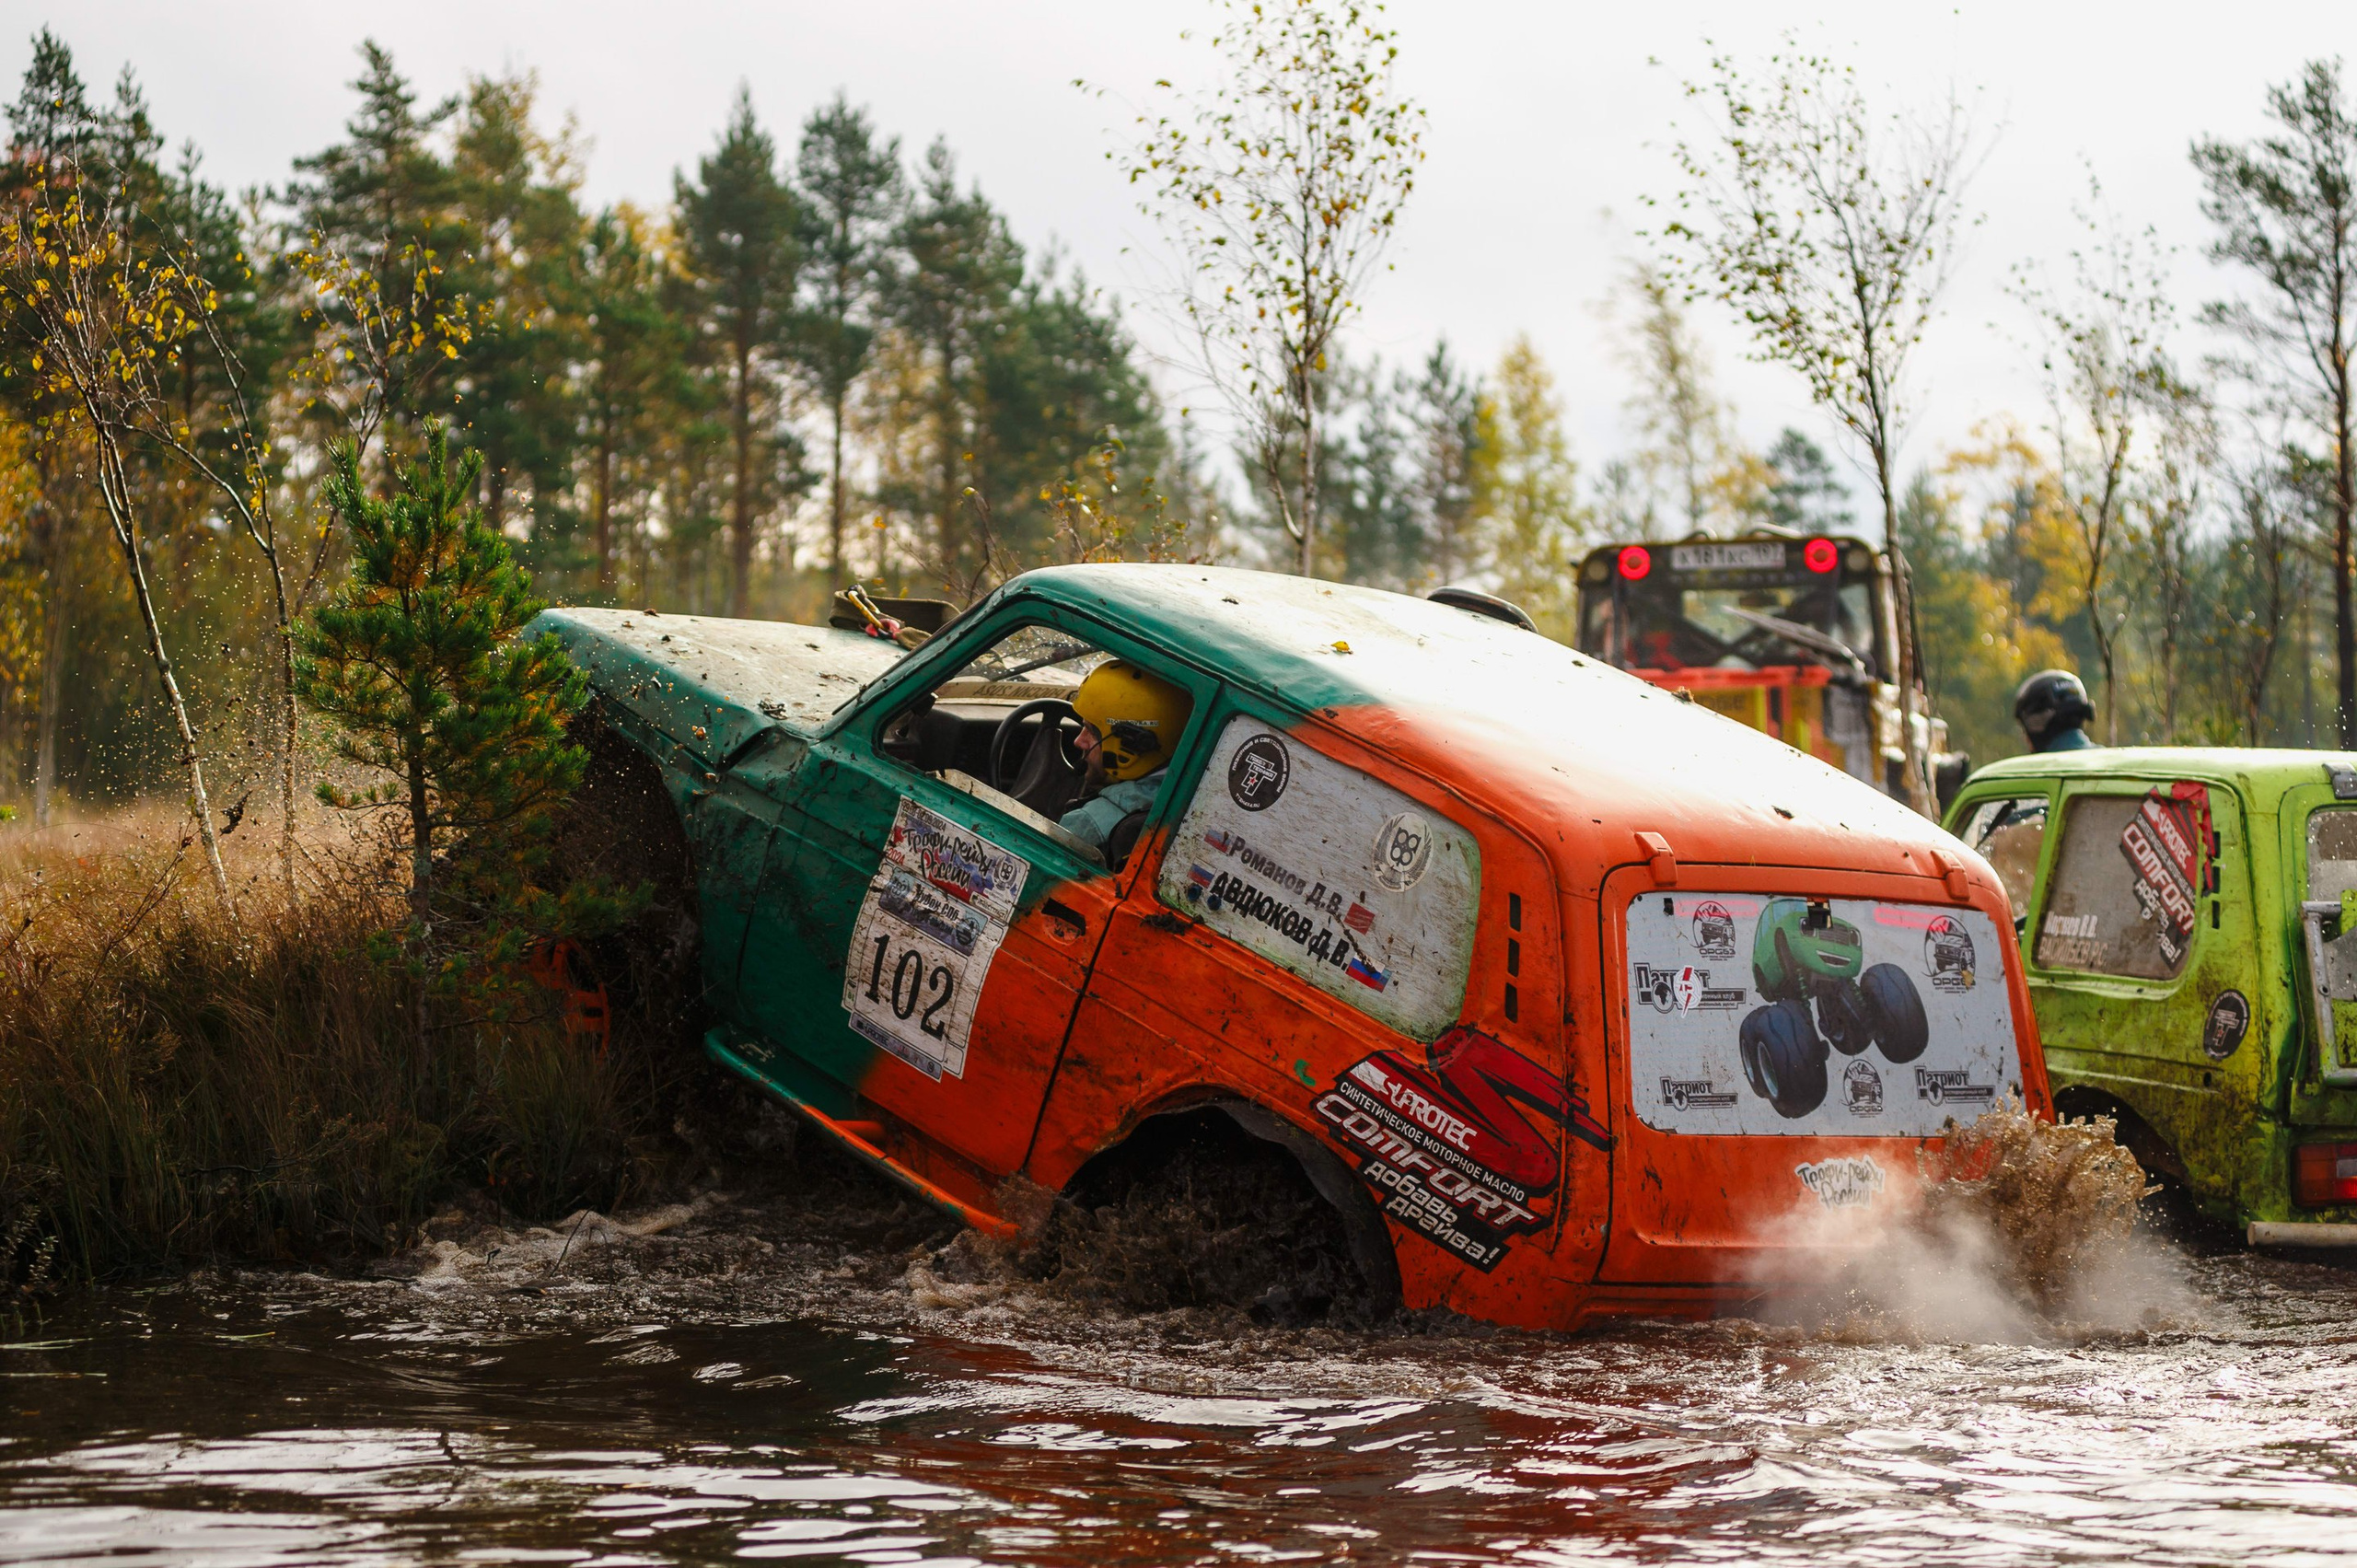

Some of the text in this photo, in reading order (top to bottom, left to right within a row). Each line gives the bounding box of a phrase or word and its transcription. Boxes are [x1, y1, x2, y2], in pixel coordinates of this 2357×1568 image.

[1210, 871, 1313, 945] АВДЮКОВ
[1229, 835, 1306, 895] Романов
[865, 933, 954, 1041] 102
[1340, 1081, 1525, 1202] СИНТЕТИЧЕСКОЕ МОТОРНОЕ МАСЛО
